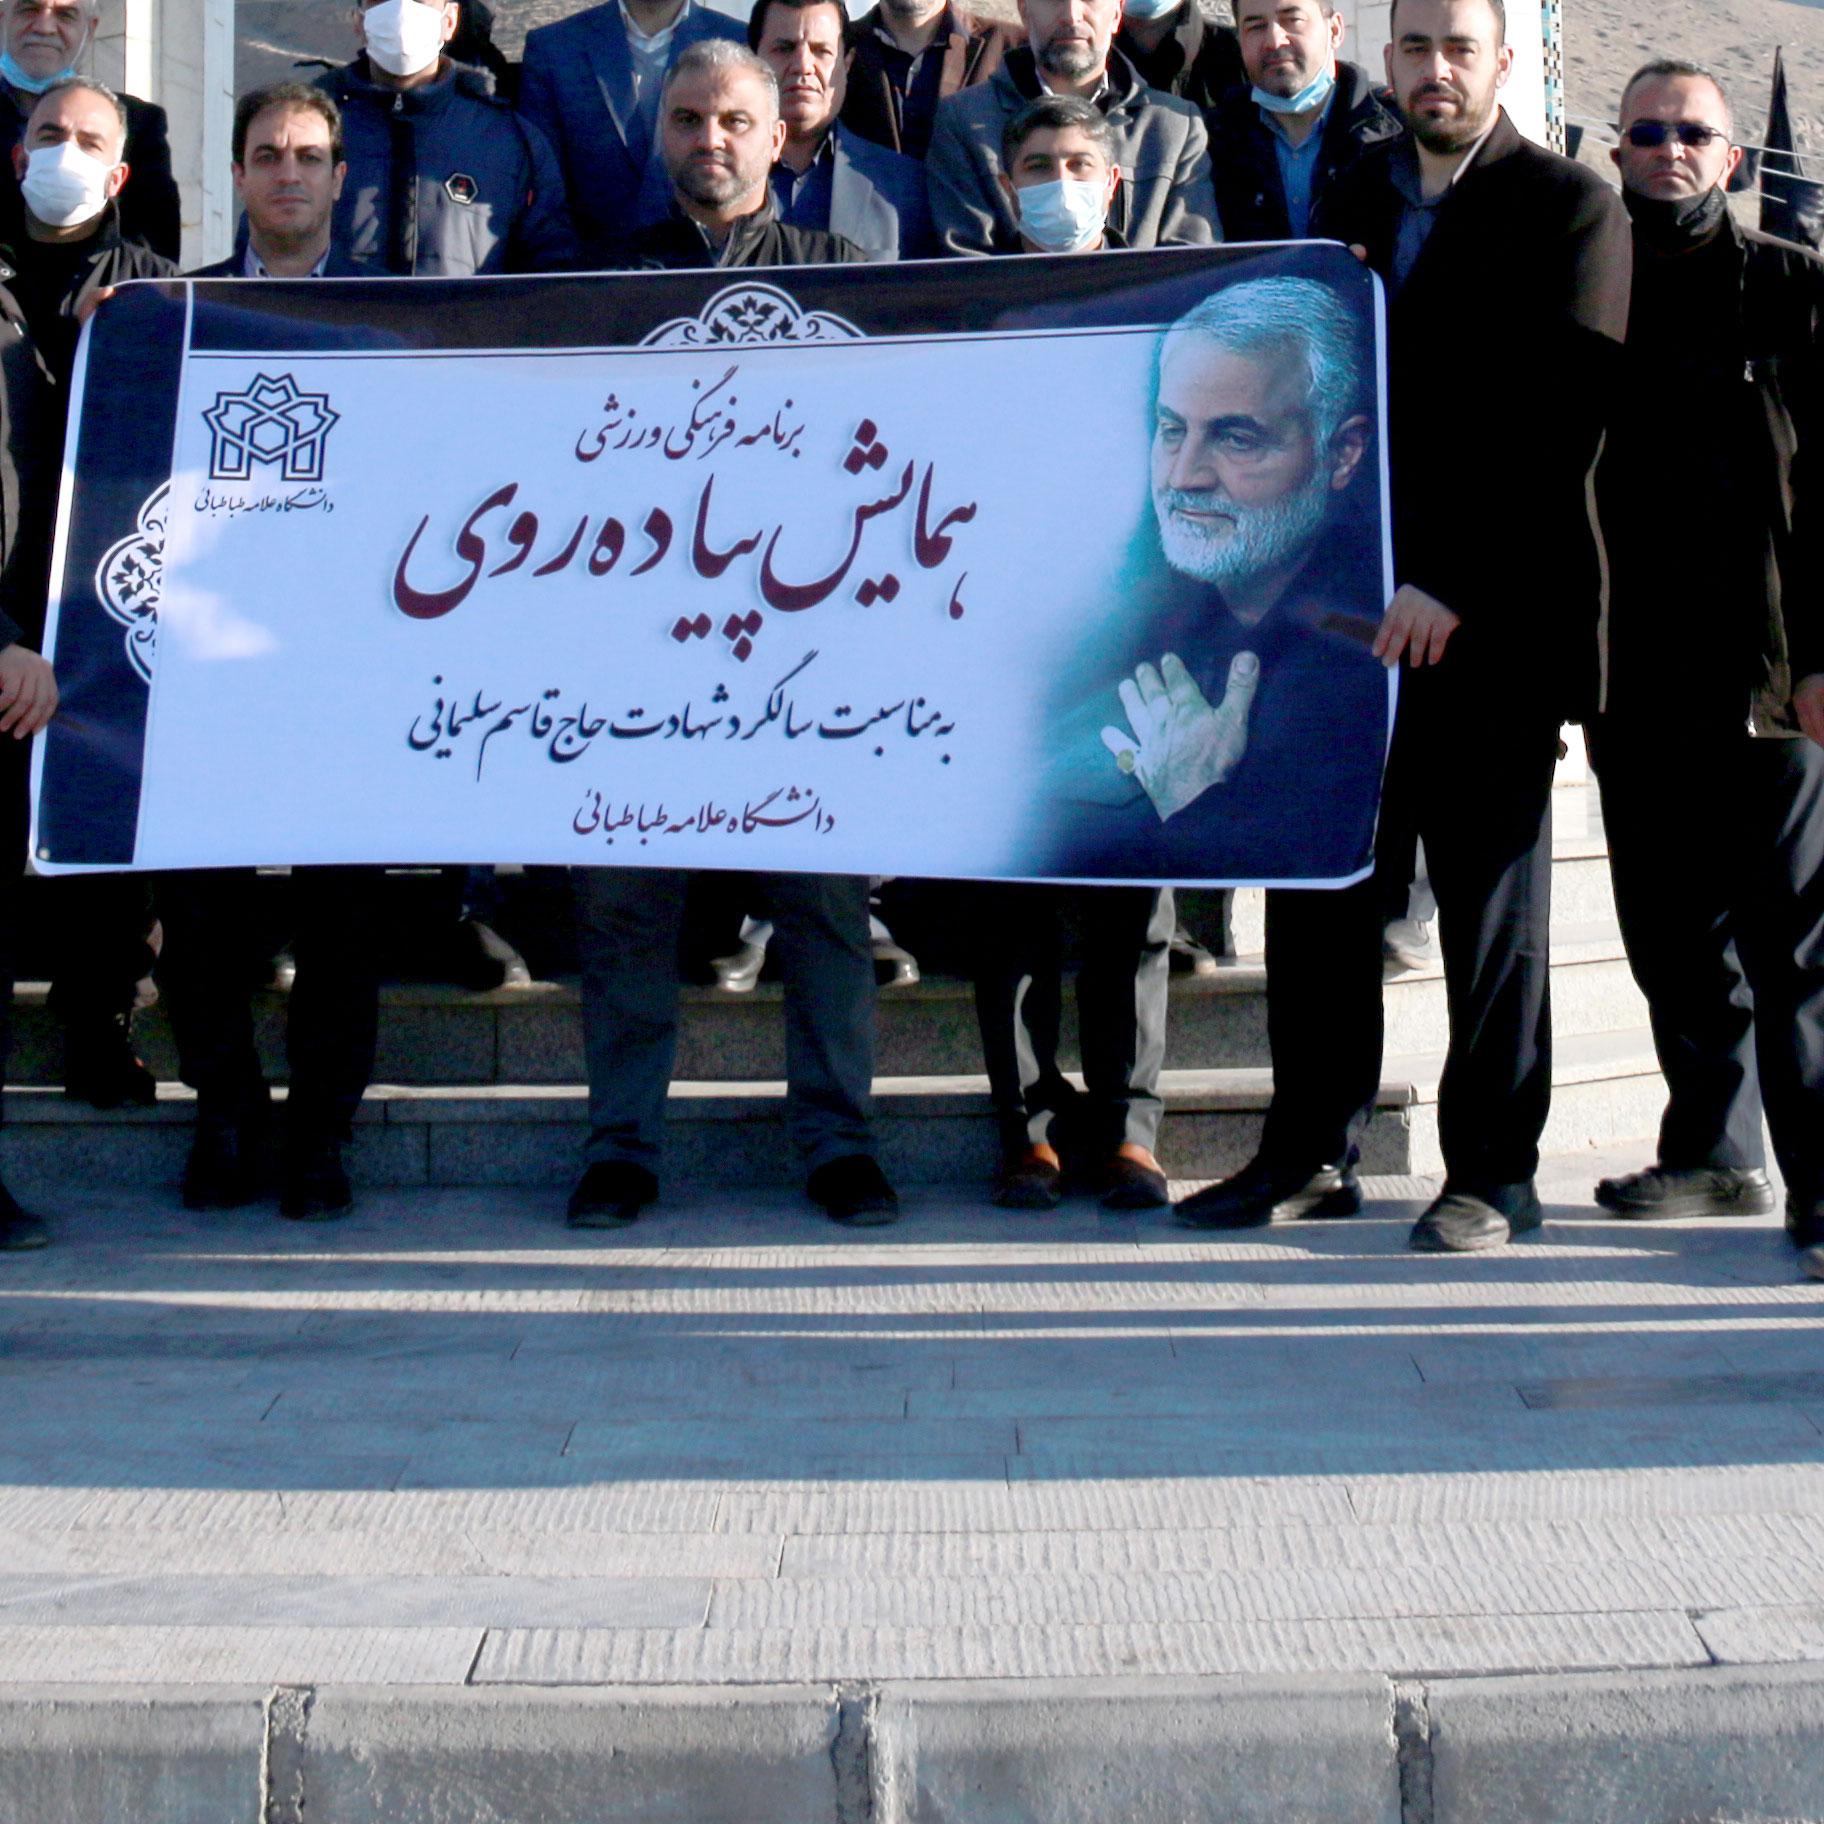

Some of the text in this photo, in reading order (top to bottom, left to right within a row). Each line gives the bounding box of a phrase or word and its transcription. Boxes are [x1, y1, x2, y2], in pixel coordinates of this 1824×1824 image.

[575, 364, 806, 463] برنامه فرهنگی ورزشی
[759, 417, 978, 621] همایش
[407, 674, 503, 759] سلیمانی
[476, 687, 554, 782] قاسم
[548, 701, 607, 764] حاج
[608, 683, 724, 740] شهادت
[724, 649, 820, 740] سالگرد
[662, 800, 728, 835] علامه
[726, 784, 836, 835] دانشگاه
